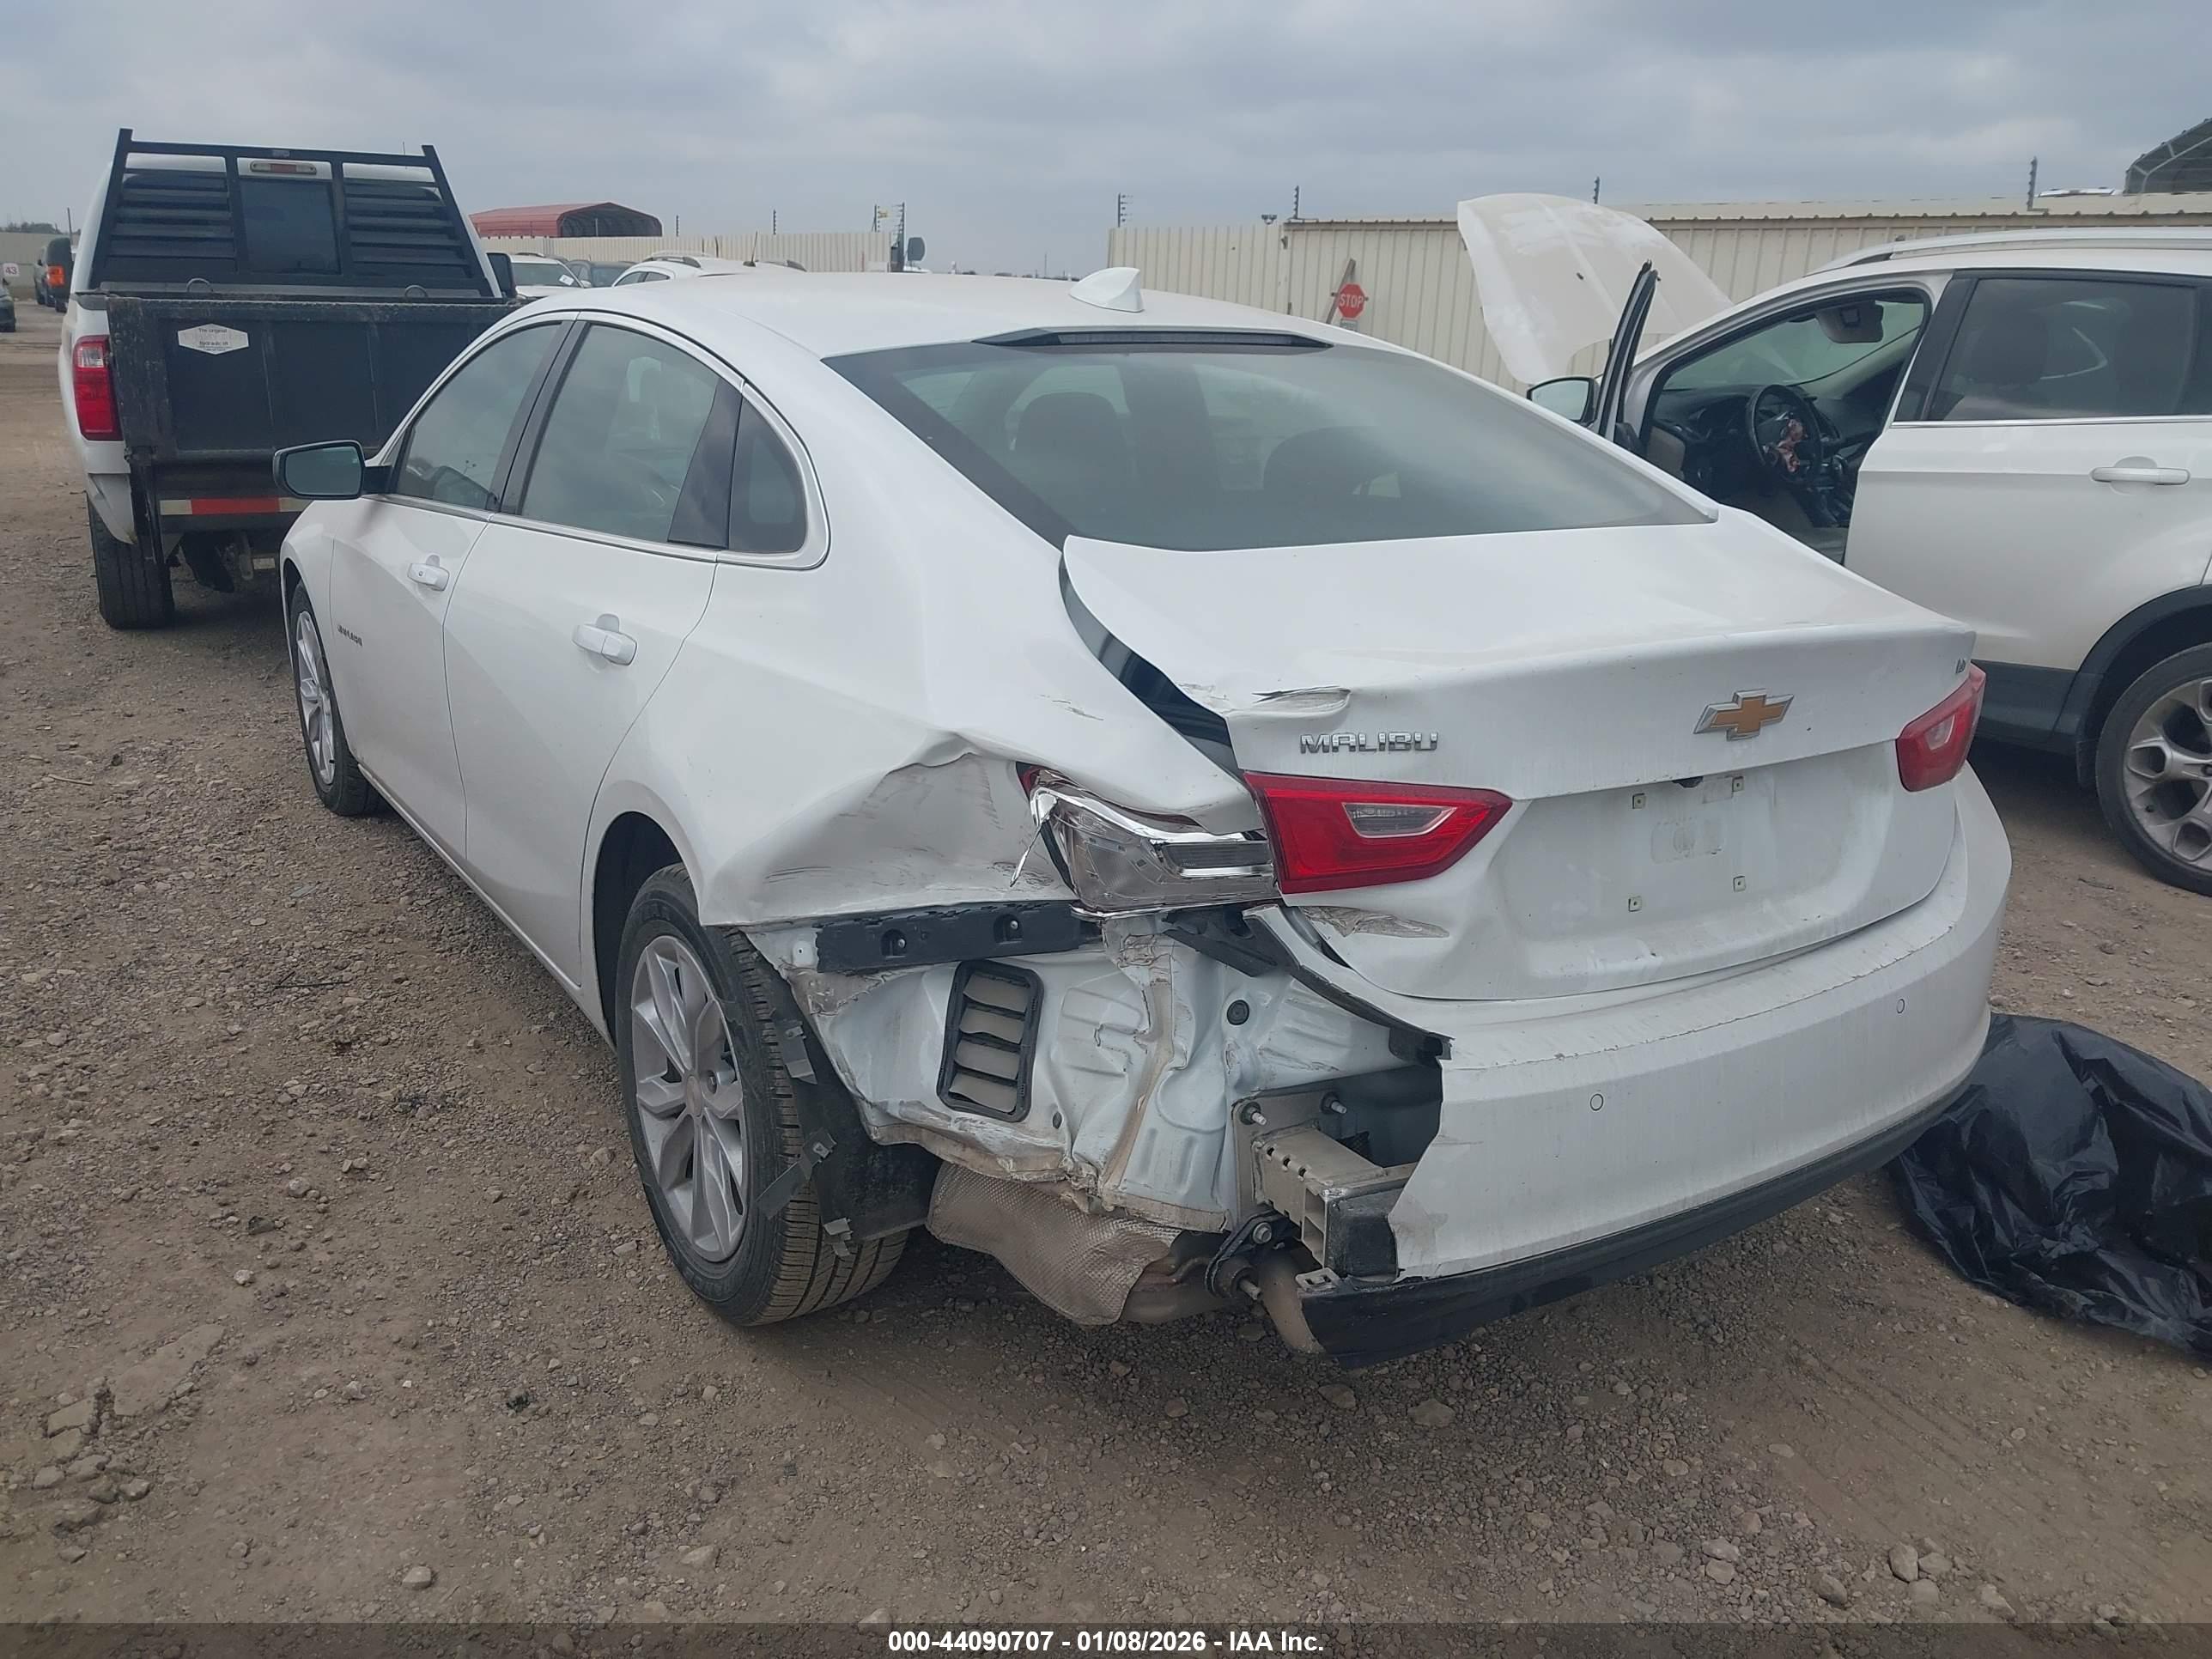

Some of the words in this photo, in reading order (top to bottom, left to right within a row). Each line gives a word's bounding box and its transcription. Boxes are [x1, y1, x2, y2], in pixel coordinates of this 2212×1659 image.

[6, 266, 17, 275] 43
[1340, 294, 1364, 308] STOP
[1300, 732, 1438, 754] MALIBU
